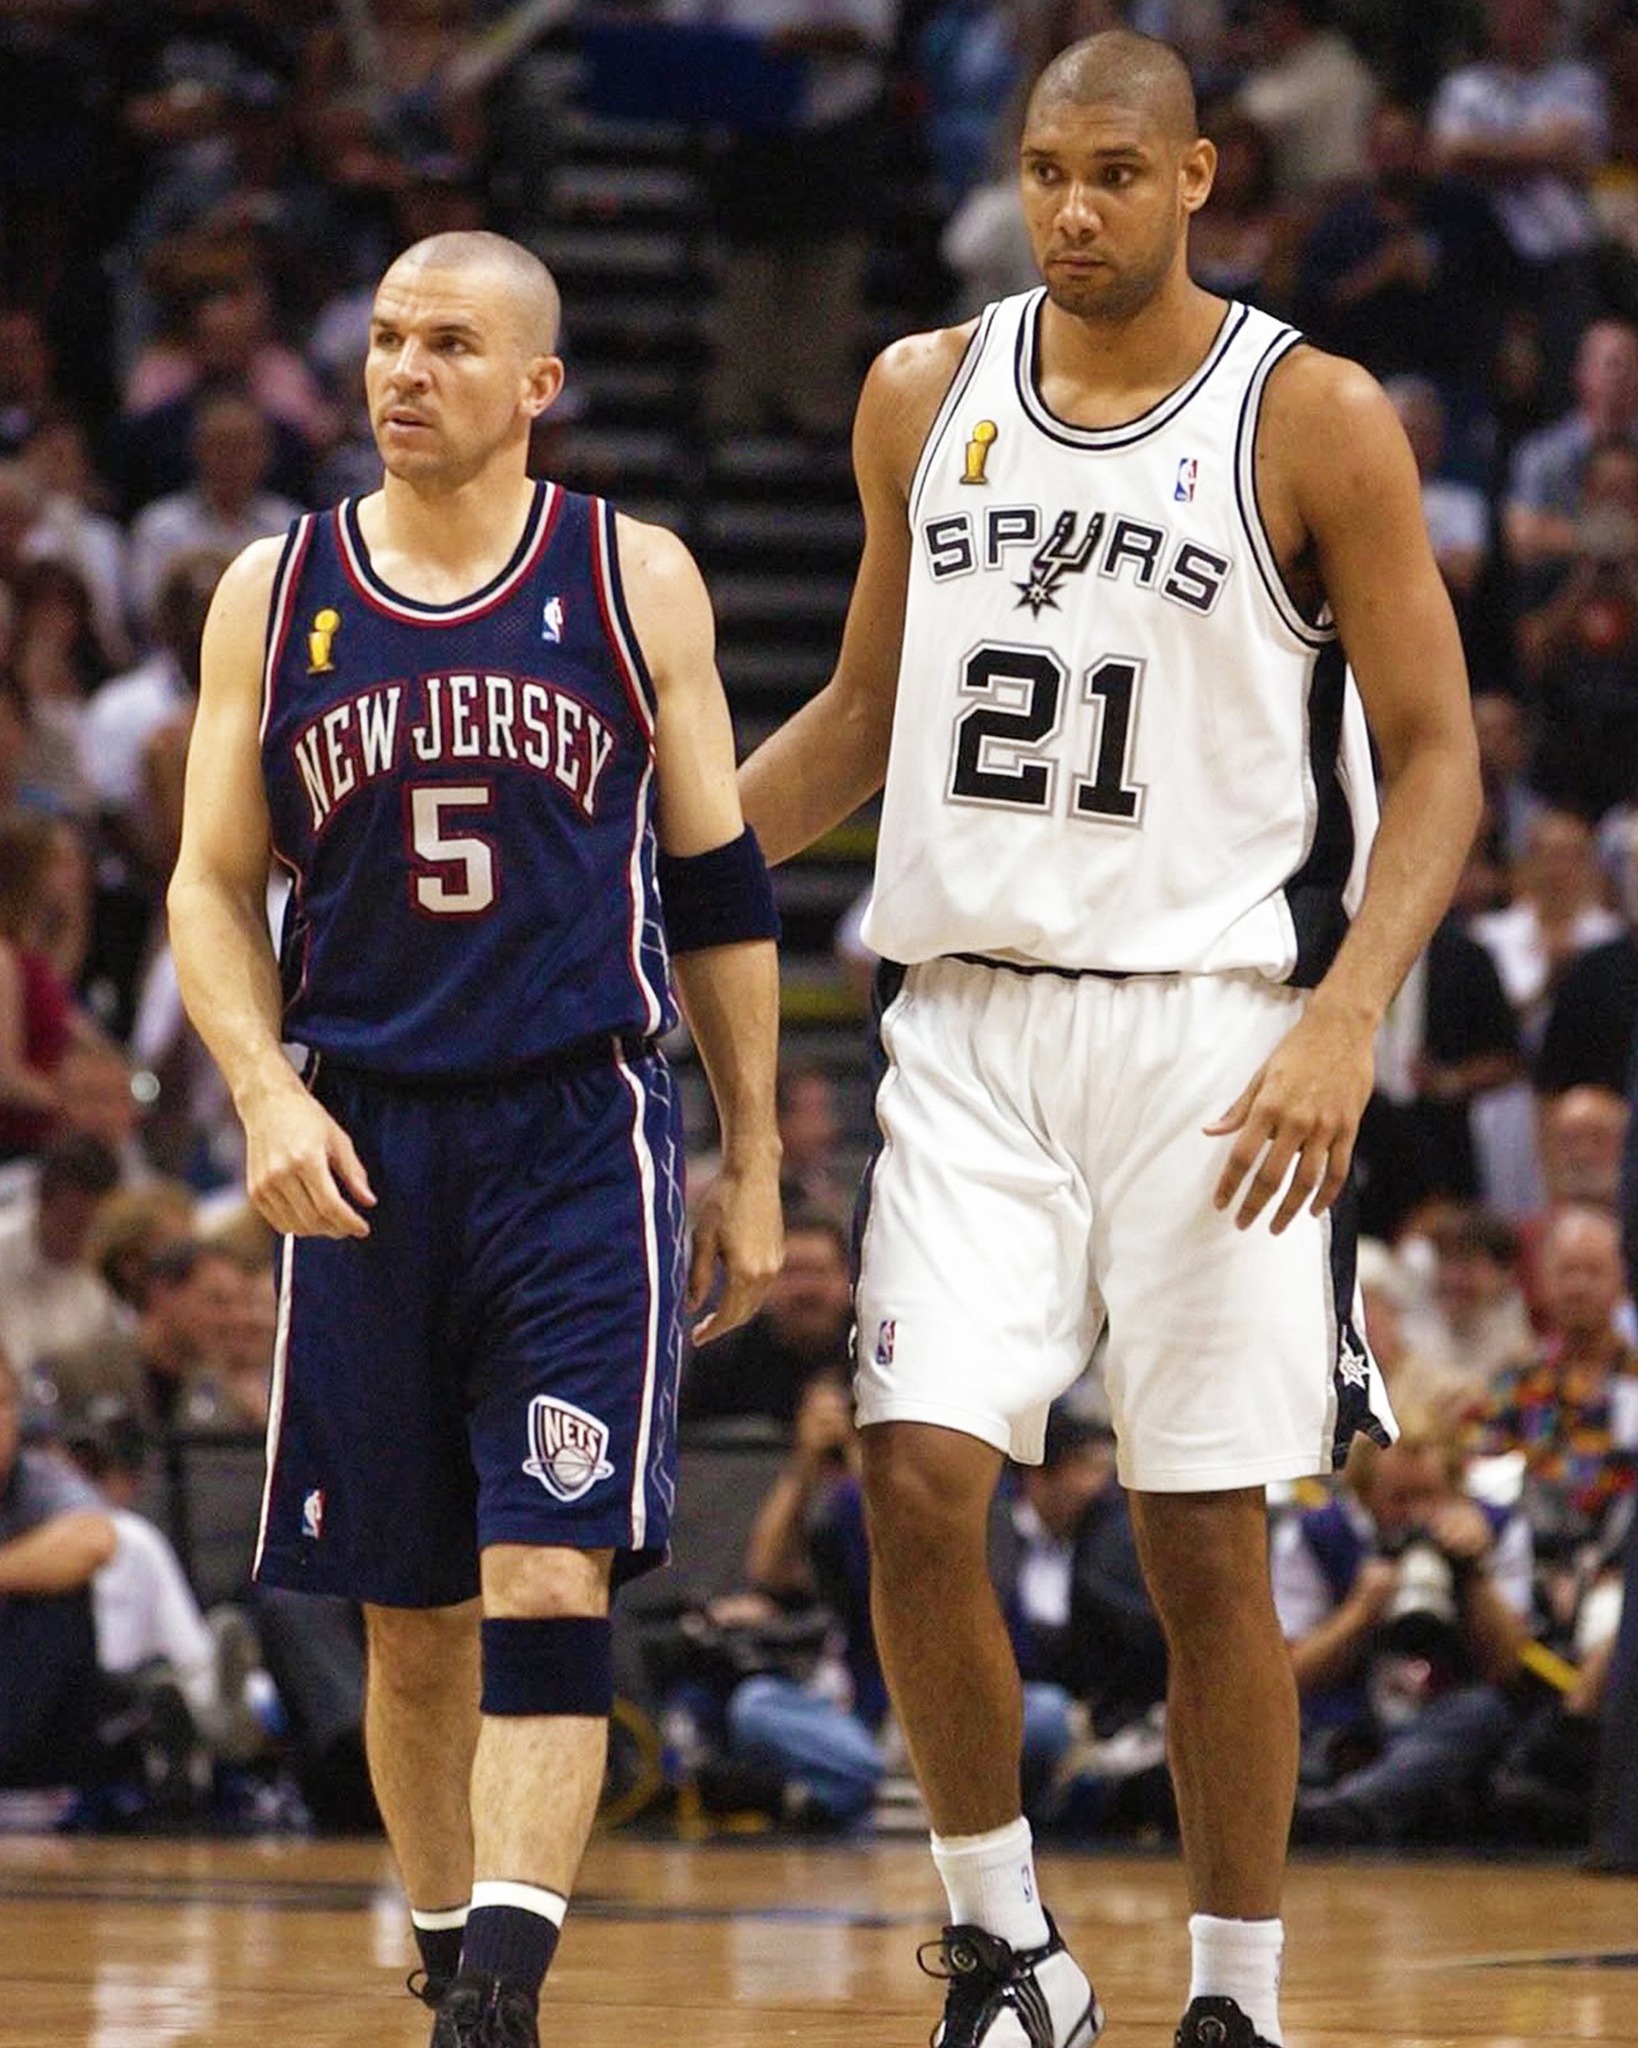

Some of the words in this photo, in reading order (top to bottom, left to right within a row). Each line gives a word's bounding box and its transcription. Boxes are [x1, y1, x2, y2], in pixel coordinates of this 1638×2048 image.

[924, 505, 1231, 618] SPURS
[294, 684, 402, 832] NEW
[411, 674, 615, 818] JERSEY
[945, 640, 1147, 828] 21
[409, 783, 496, 916] 5
[543, 1406, 600, 1459] NETS
